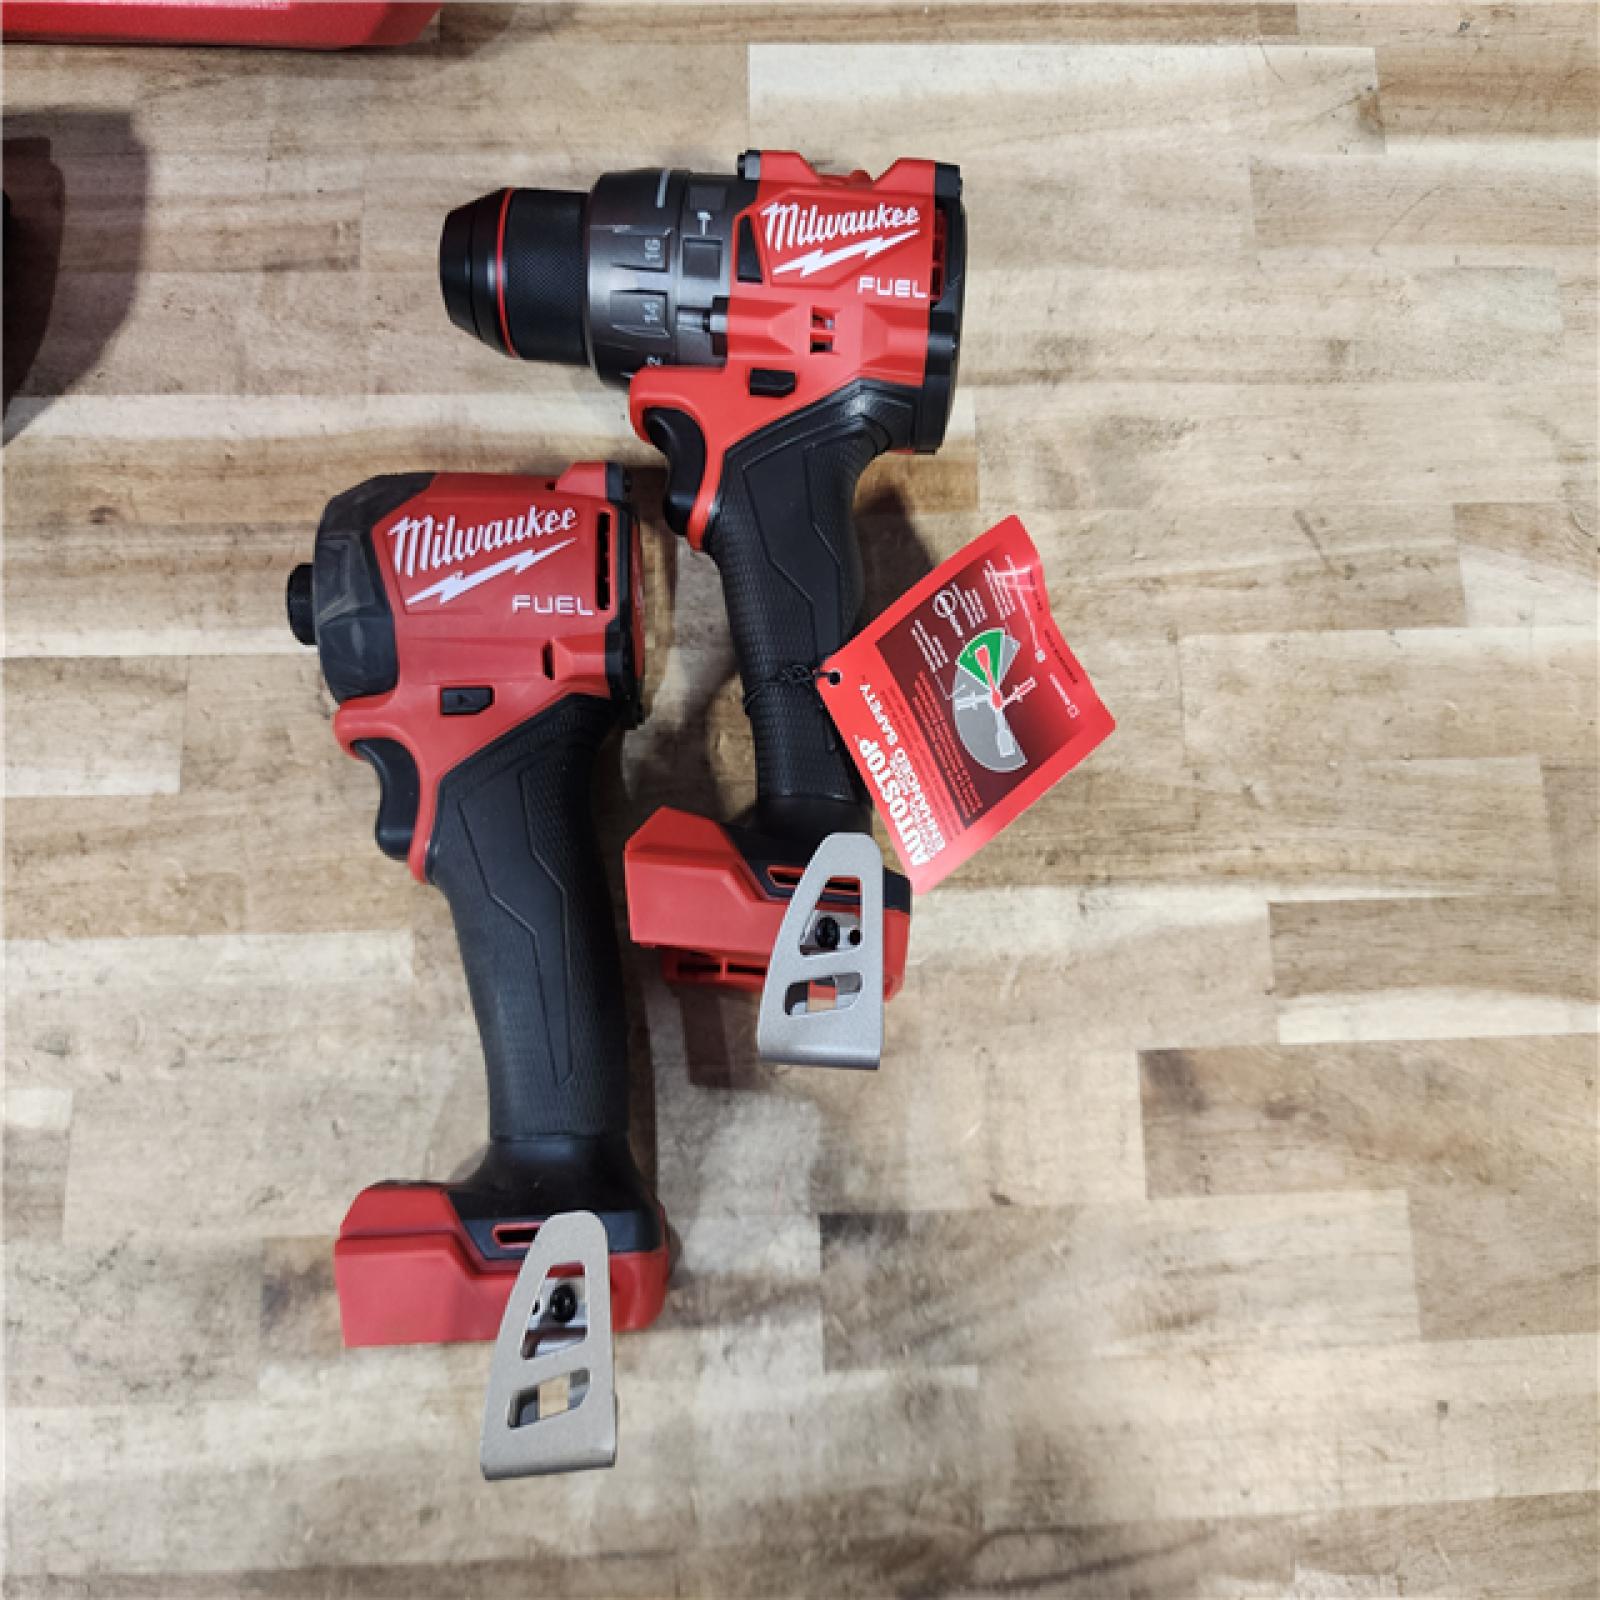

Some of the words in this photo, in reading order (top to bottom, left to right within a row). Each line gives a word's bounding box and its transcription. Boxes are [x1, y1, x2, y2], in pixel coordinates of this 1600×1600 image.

[760, 202, 920, 252] Milwaukee
[856, 275, 928, 299] FUEL
[387, 505, 578, 578] Milwaukee
[511, 594, 595, 617] FUEL
[859, 738, 931, 866] AUTOSTOP
